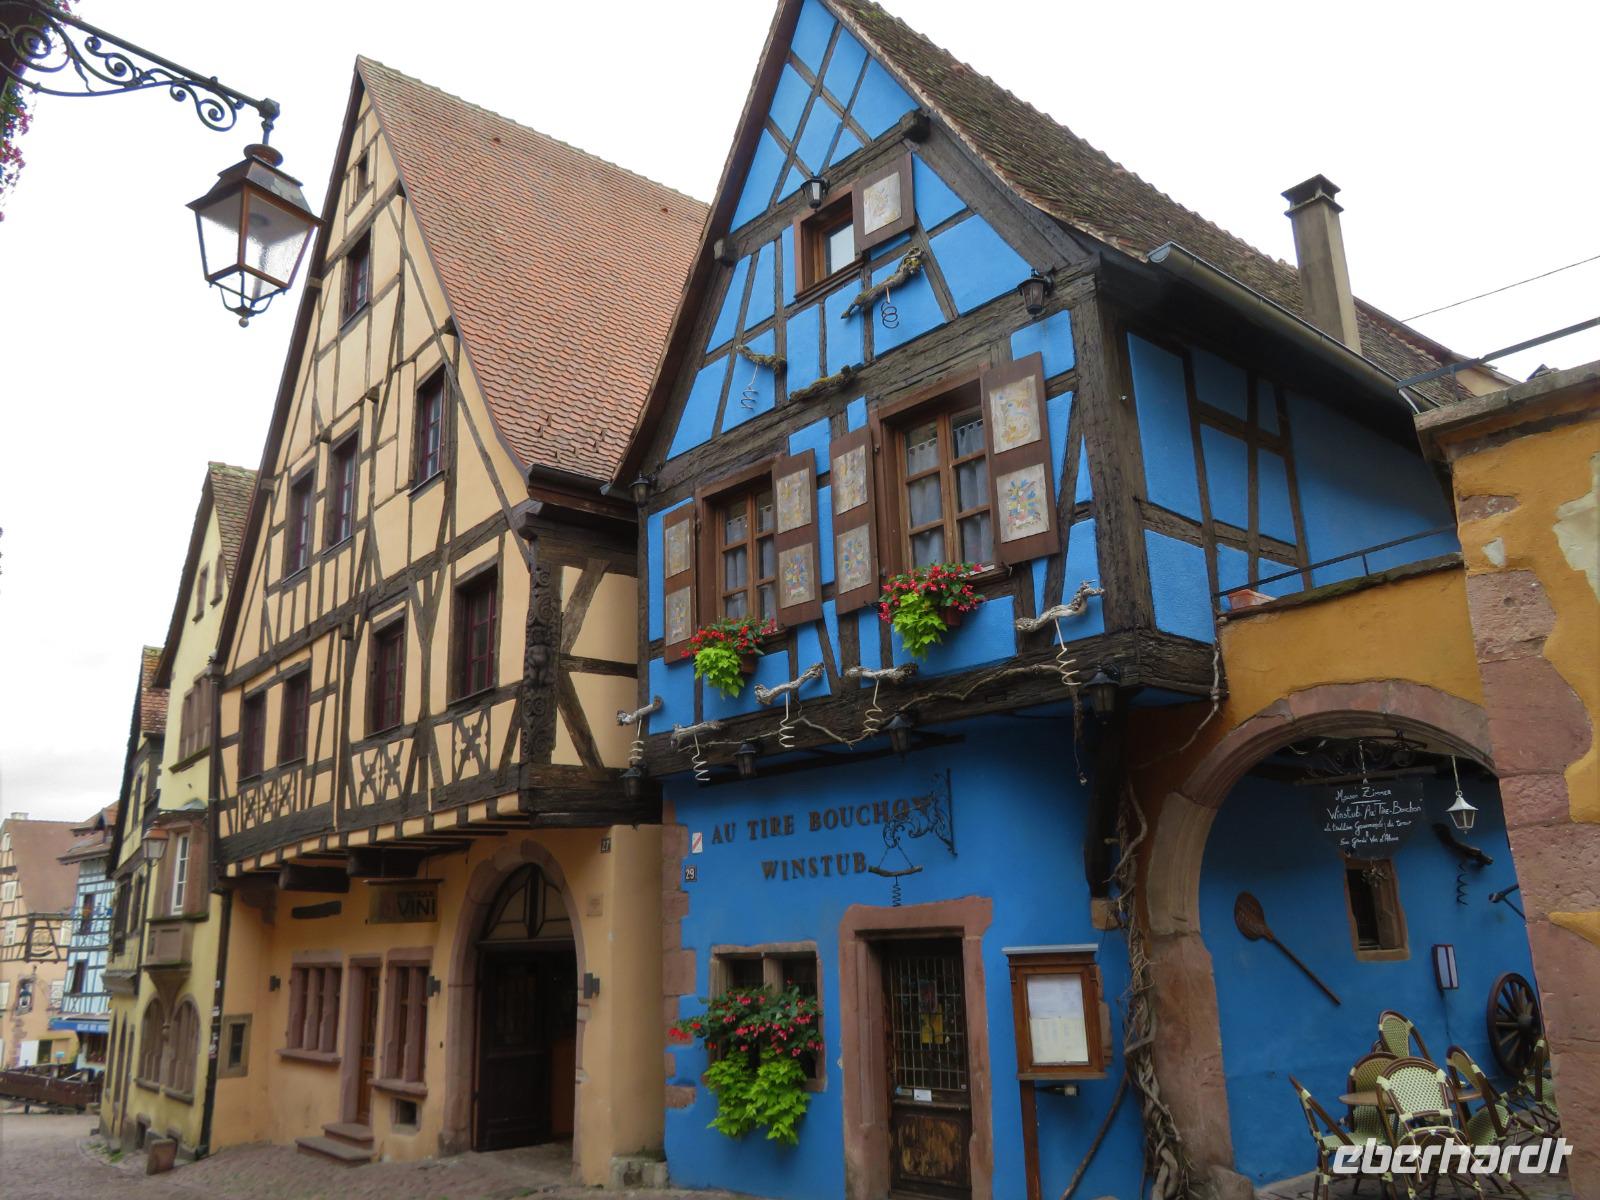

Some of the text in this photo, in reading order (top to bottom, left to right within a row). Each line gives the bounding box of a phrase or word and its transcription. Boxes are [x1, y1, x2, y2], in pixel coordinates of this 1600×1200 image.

[711, 822, 736, 844] AU
[747, 814, 795, 840] TIRE
[685, 868, 695, 880] 29
[761, 852, 867, 881] WINSTUB
[397, 897, 436, 916] VINI
